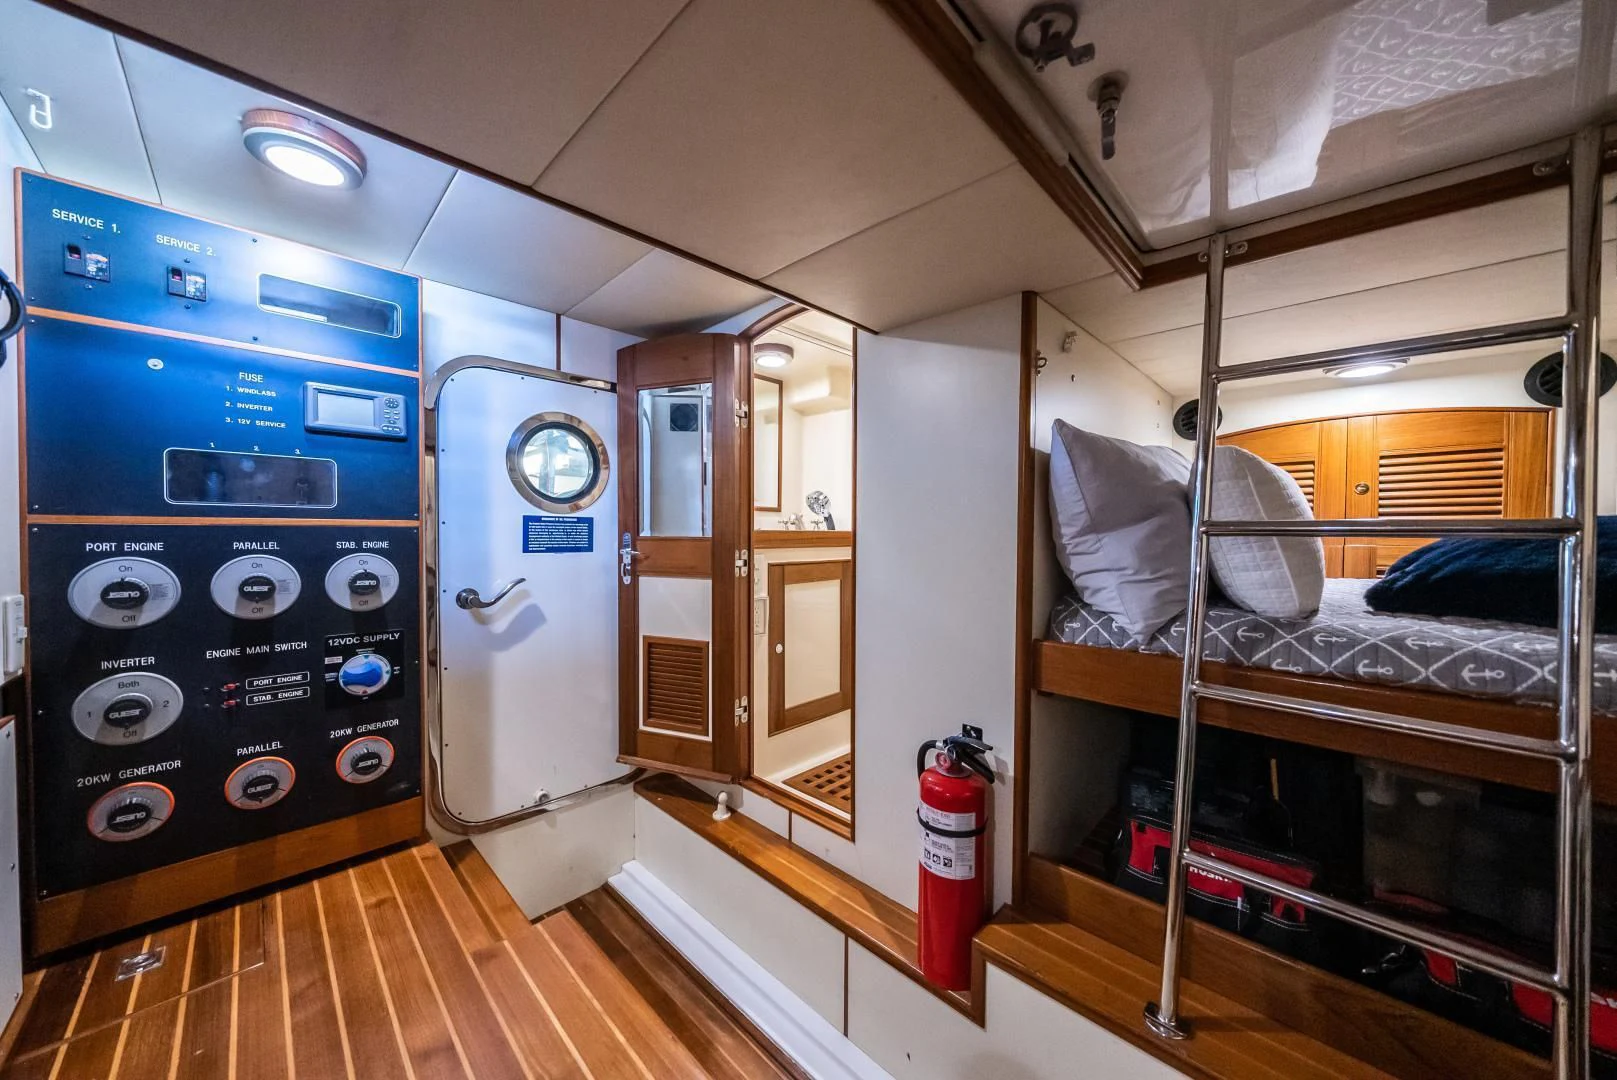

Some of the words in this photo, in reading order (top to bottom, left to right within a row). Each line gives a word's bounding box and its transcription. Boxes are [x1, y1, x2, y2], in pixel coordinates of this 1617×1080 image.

[52, 208, 104, 229] SERVICE
[111, 223, 121, 234] 1.
[156, 234, 201, 253] SERVICE
[206, 246, 216, 257] 2.
[239, 372, 264, 383] FUSE
[237, 386, 276, 397] WINDLASS
[237, 402, 273, 412] INVERTER
[255, 420, 287, 429] SERVICE
[85, 542, 117, 552] PORT
[124, 542, 164, 551] ENGINE
[233, 541, 280, 550] PARALLEL
[336, 541, 358, 549] STAB.
[362, 541, 390, 549] ENGINE
[118, 565, 133, 573] On
[121, 615, 137, 623] Off
[328, 636, 361, 647] 12VDC
[362, 632, 401, 643] SUPPLY
[206, 647, 242, 660] ENGINE
[246, 645, 270, 655] MAIN
[274, 641, 308, 652] SWITCH
[101, 656, 155, 669] INVERTER
[118, 680, 140, 689] Both
[253, 678, 274, 687] PORT
[277, 674, 304, 684] ENGINE
[253, 694, 275, 703] STAB.
[278, 689, 305, 699] ENGINE
[162, 700, 170, 708] 2
[108, 708, 143, 719] GUEST
[122, 730, 137, 738] Off
[329, 727, 353, 739] 20KW
[356, 718, 399, 733] GENERATOR
[236, 741, 284, 756] PARALLEL
[76, 773, 111, 788] 20KW
[118, 759, 181, 779] GENERATOR
